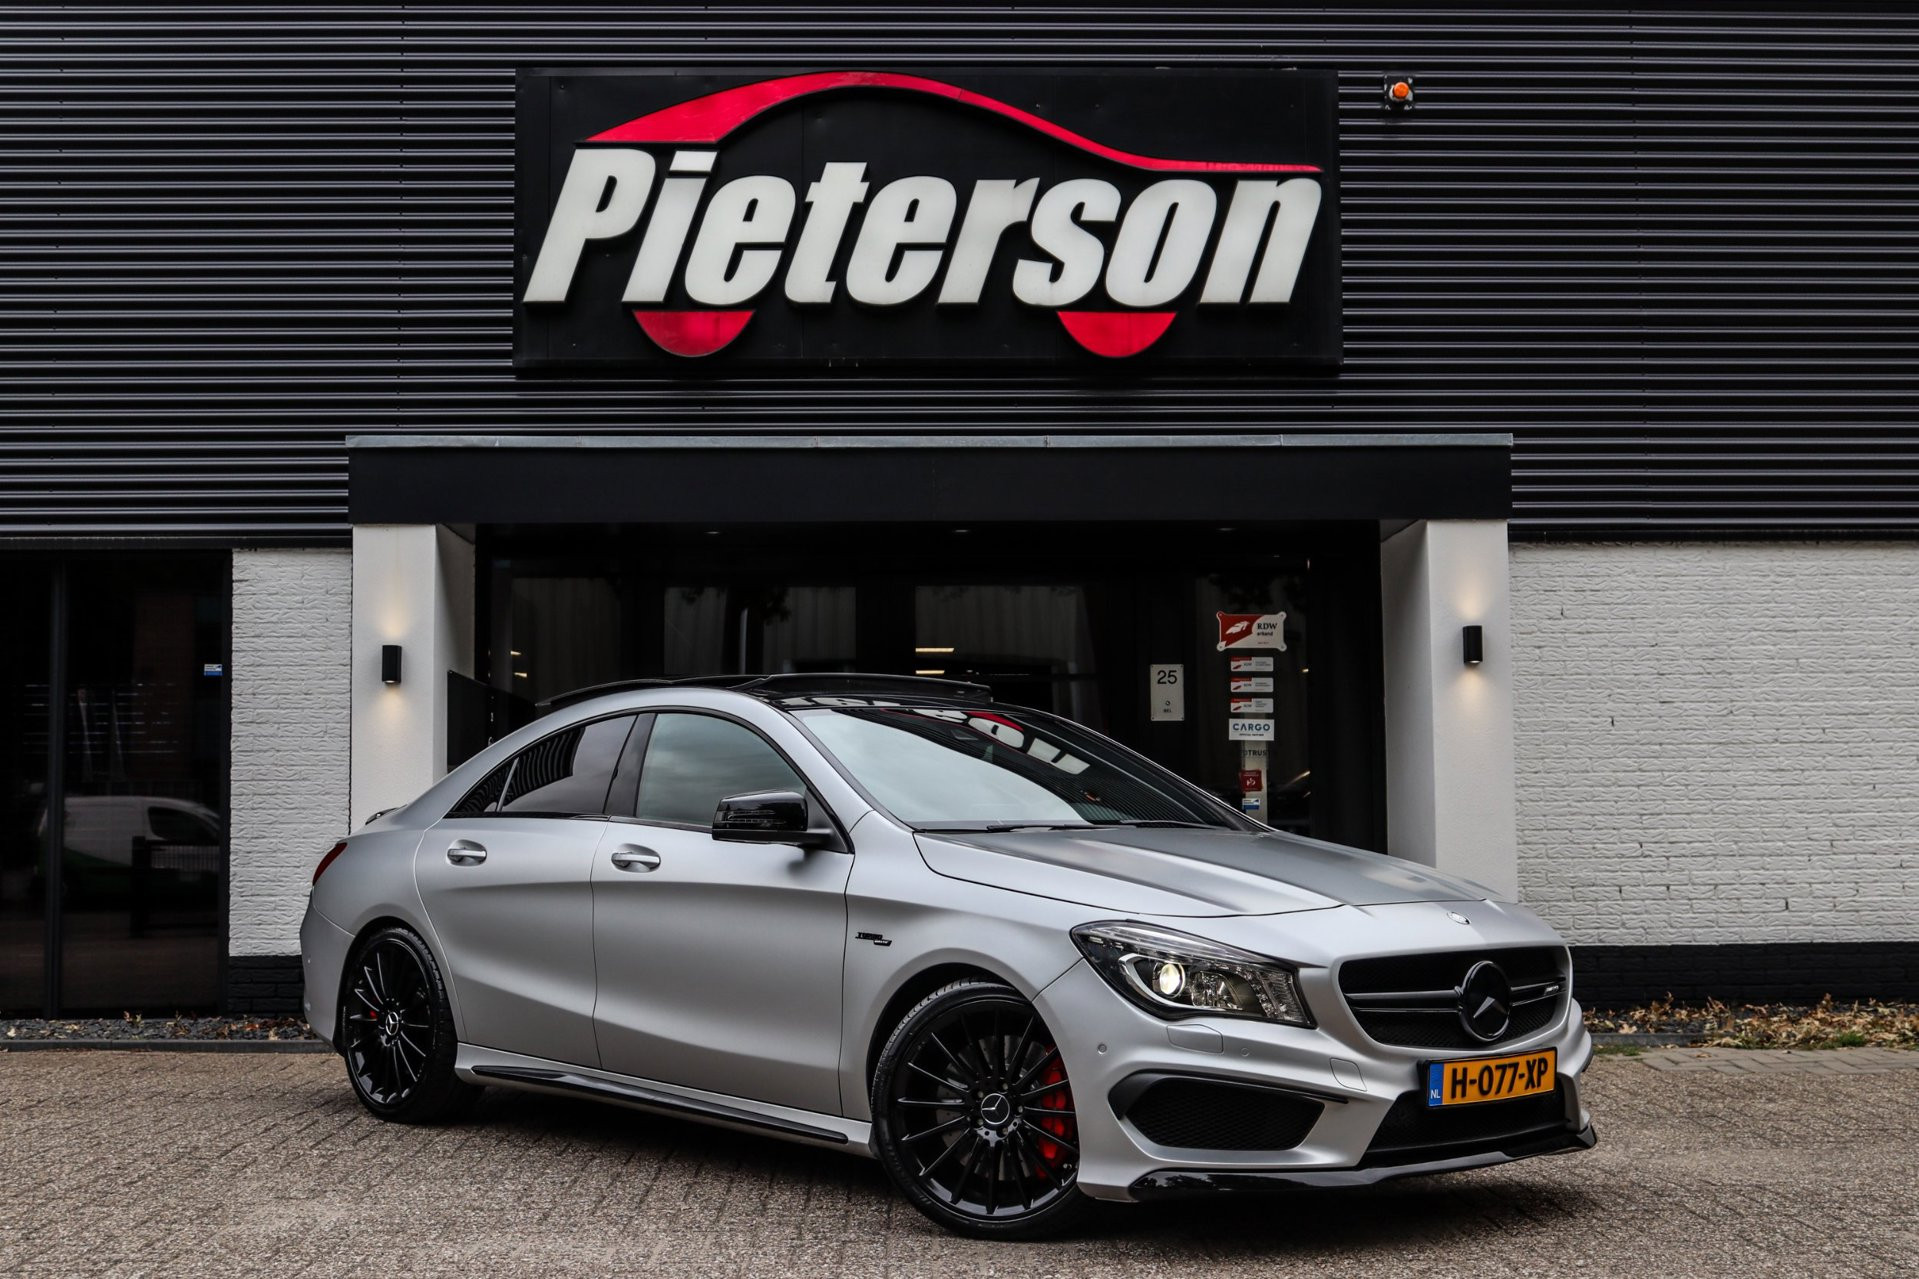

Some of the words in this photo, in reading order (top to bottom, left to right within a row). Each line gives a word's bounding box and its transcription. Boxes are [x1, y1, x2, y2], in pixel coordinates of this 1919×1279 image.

[522, 147, 1324, 308] Pieterson
[1257, 622, 1278, 630] RDW
[1157, 670, 1178, 685] 25
[1232, 723, 1271, 732] CARGO
[1451, 1057, 1548, 1099] H-077-XP
[1430, 1089, 1441, 1099] NL
